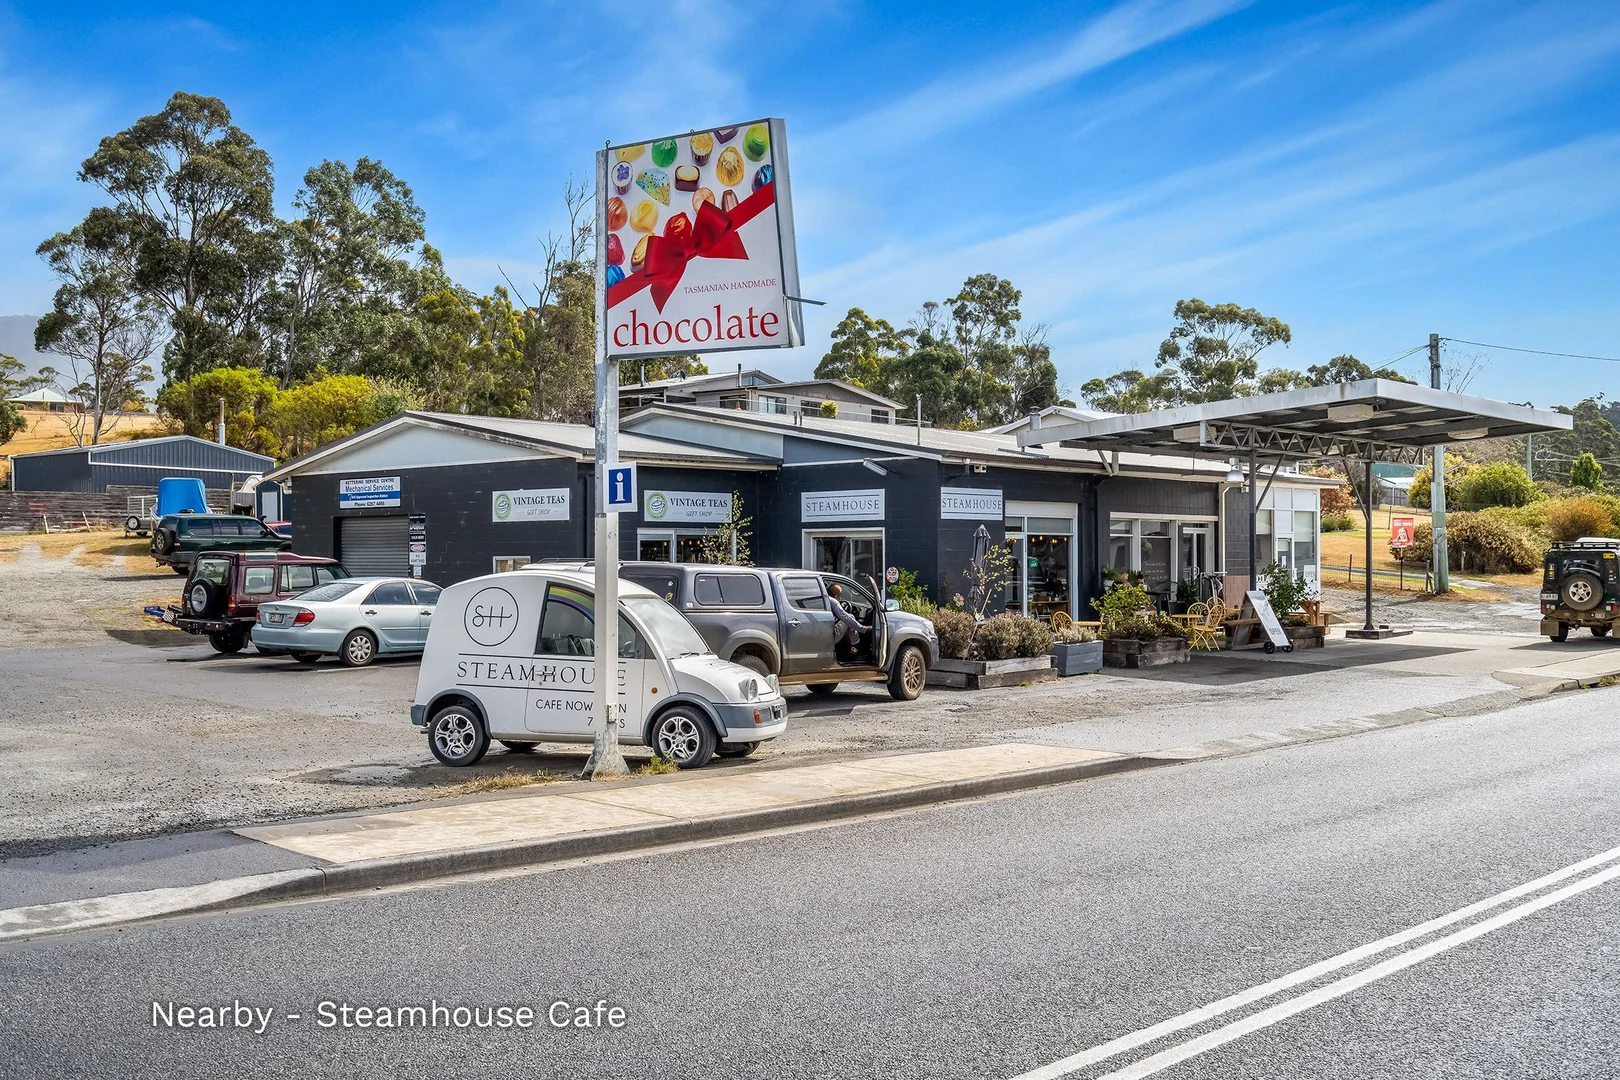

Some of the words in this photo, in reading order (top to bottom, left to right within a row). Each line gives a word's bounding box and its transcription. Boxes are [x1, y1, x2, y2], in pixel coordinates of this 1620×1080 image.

[684, 283, 729, 295] TASMANIAN
[730, 278, 777, 290] HANDMADE
[613, 304, 779, 347] chocolate
[513, 496, 545, 505] VINTAGE
[546, 495, 565, 504] TEAS
[670, 498, 706, 507] VINTAGE
[708, 499, 728, 508] TEAS
[805, 499, 880, 512] STEAMHOUSE
[941, 497, 1002, 509] STEAMHOUSE
[456, 661, 627, 687] STEAMHOUE
[535, 699, 562, 711] CAFE
[565, 701, 594, 712] NOW
